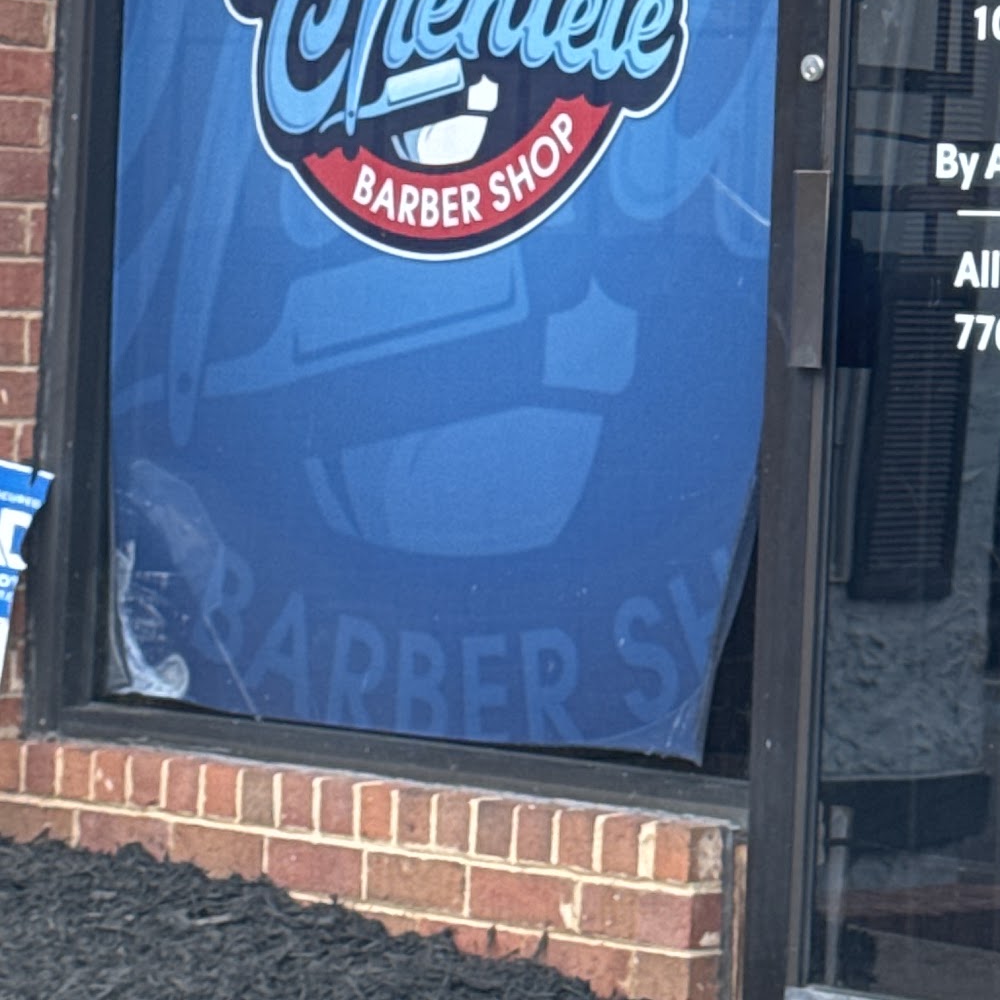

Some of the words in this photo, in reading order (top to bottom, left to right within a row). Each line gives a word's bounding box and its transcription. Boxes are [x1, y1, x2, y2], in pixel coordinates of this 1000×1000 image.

[352, 163, 483, 228] BARBER
[489, 112, 574, 212] SHOP
[935, 142, 980, 191] By
[953, 249, 1000, 289] All
